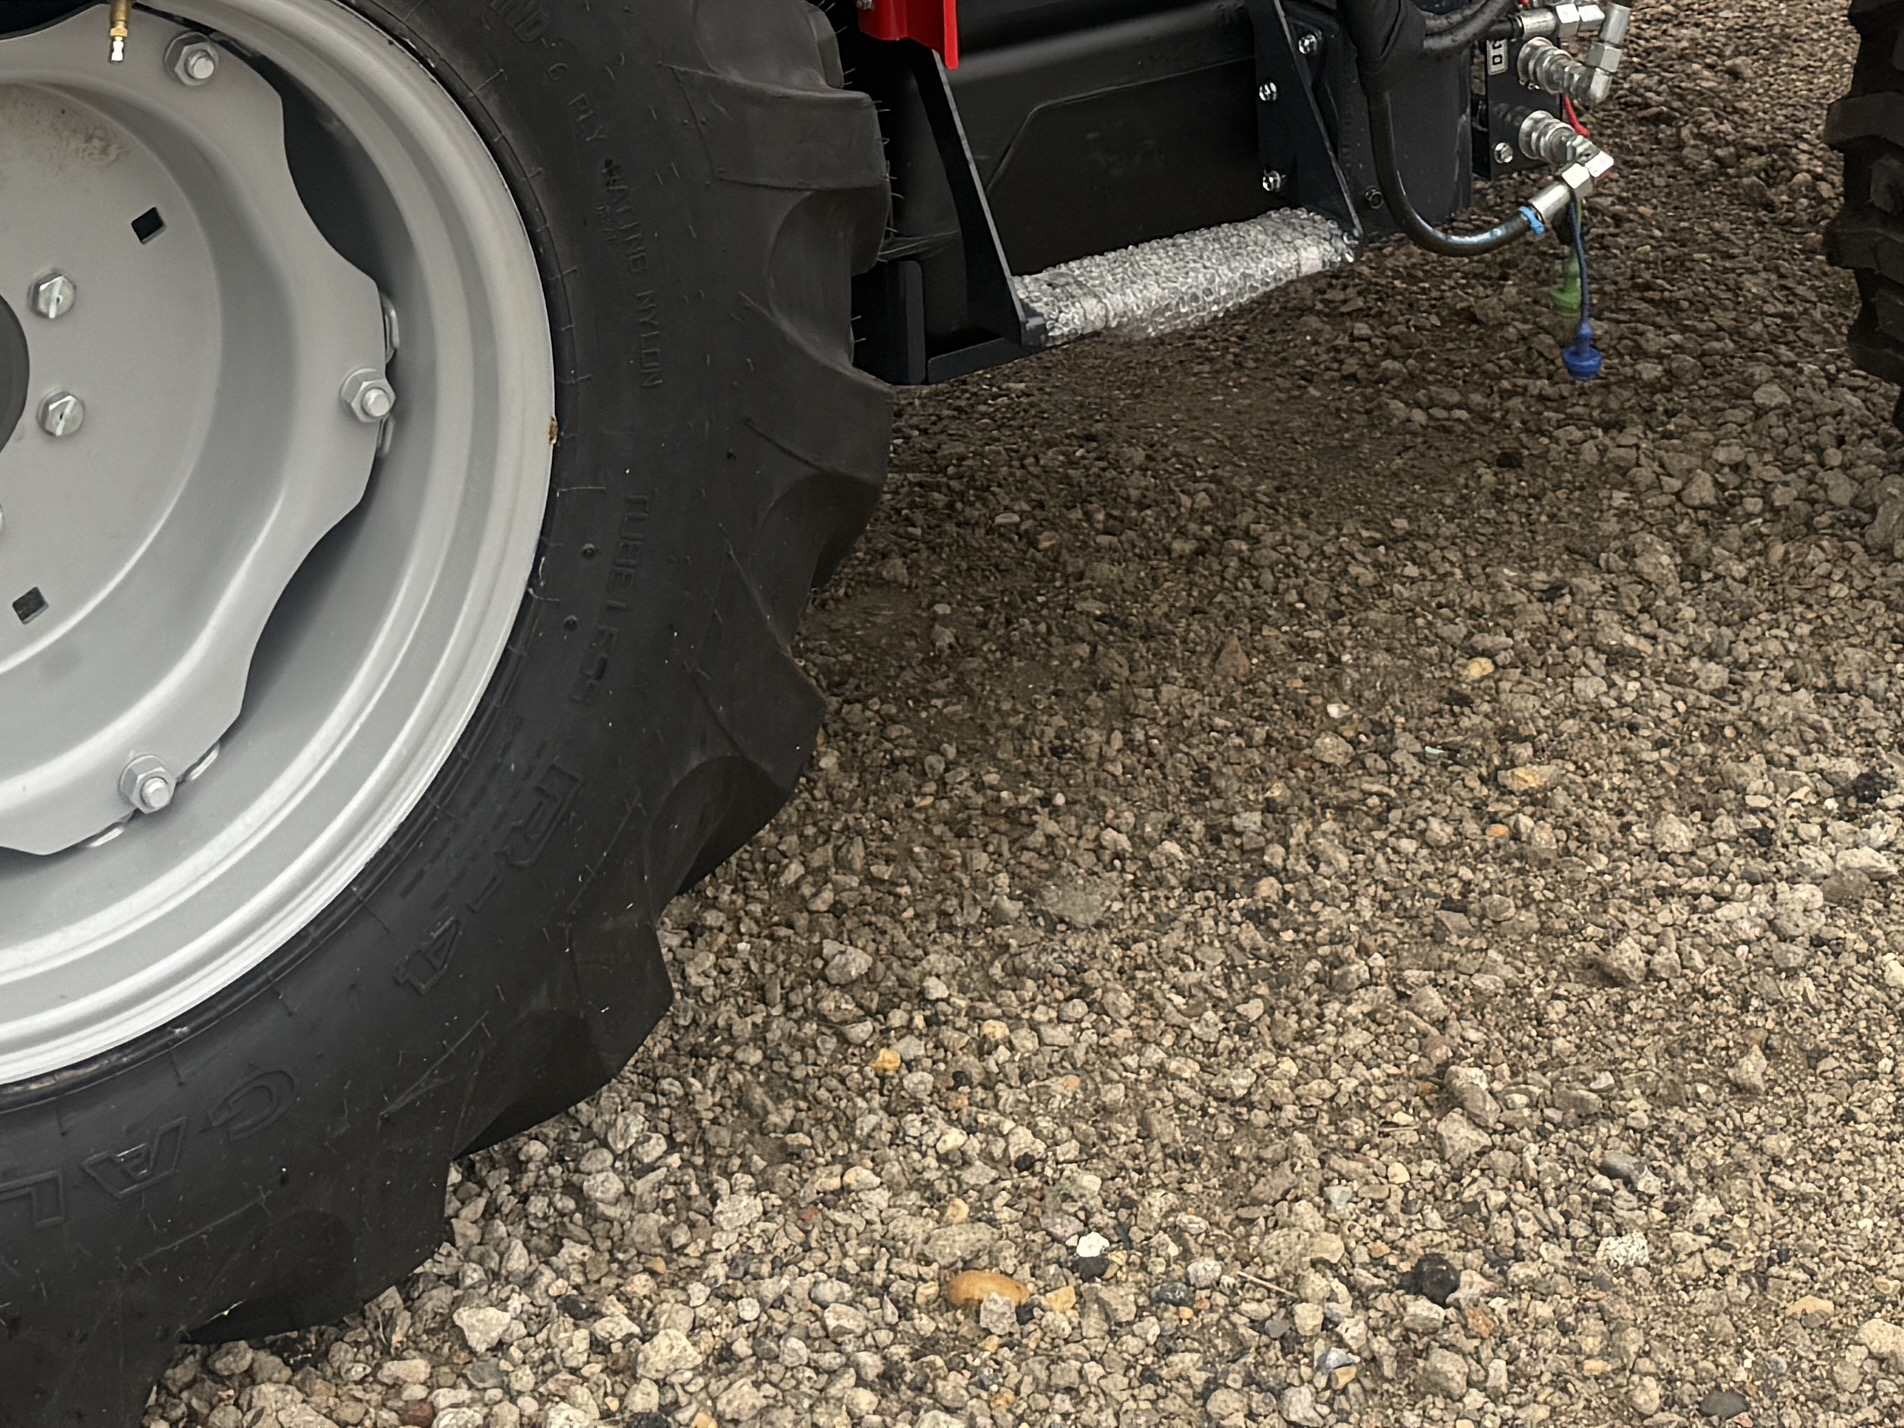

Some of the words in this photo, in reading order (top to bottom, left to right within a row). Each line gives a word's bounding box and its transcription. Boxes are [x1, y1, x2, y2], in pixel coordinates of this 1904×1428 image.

[566, 93, 609, 142] PLY
[635, 289, 665, 388] NYLON
[567, 491, 650, 707] TUBELESS
